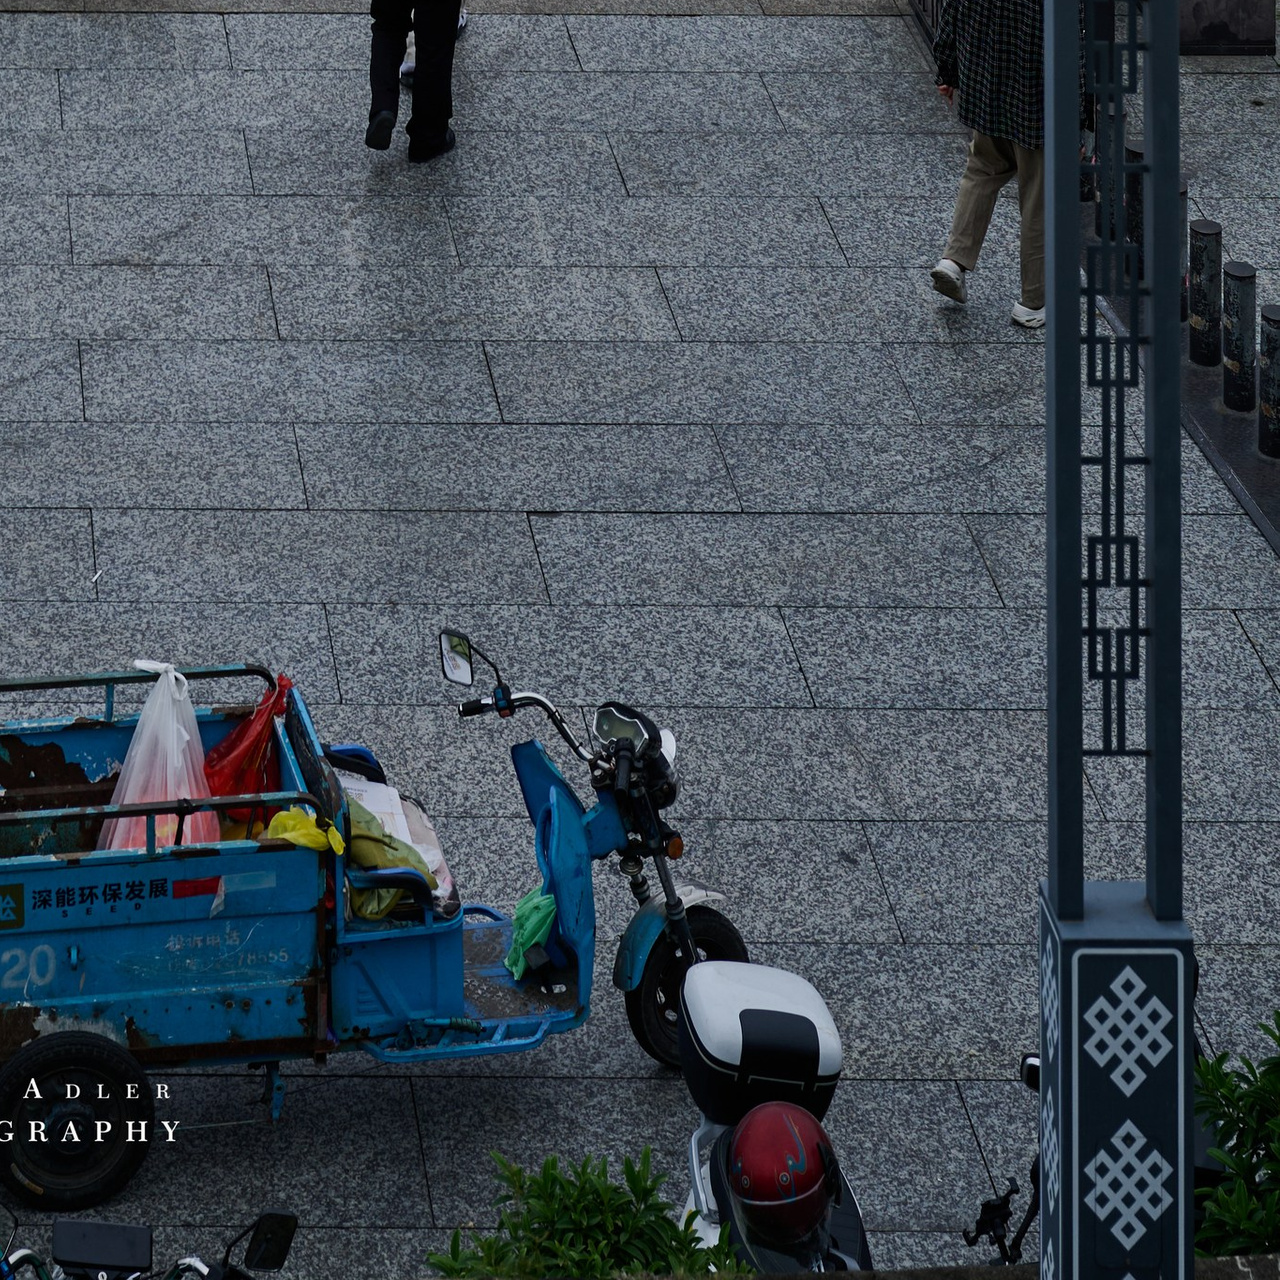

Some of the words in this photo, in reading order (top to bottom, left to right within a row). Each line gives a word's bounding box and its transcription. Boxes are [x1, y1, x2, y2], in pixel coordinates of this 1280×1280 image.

[31, 878, 169, 910] 深能环保发展
